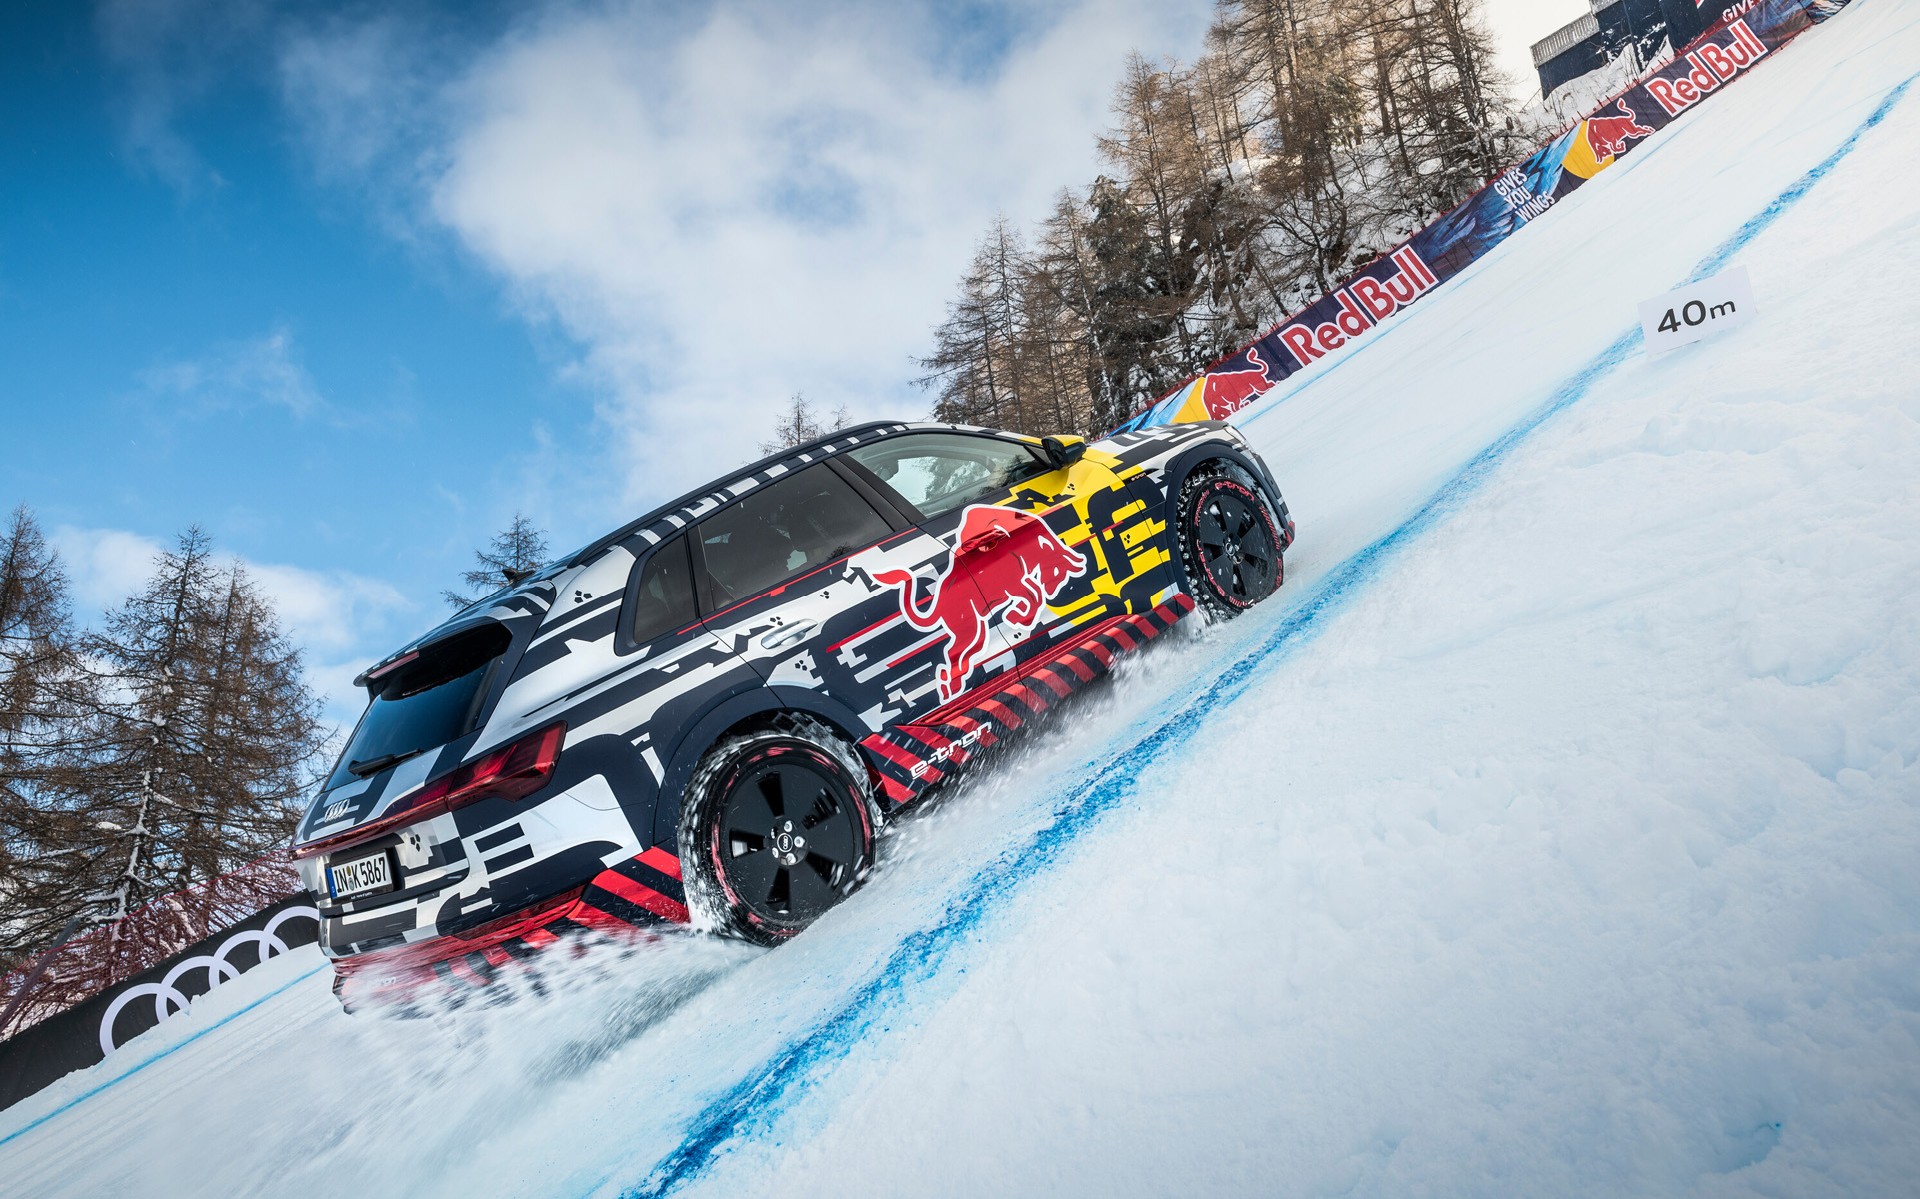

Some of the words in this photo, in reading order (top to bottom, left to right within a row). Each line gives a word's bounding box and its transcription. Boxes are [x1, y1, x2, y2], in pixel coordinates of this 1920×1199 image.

[1494, 168, 1528, 196] GIVES
[1504, 186, 1532, 209] YOU
[1515, 191, 1555, 222] WINGS
[1657, 300, 1736, 333] 40m
[1215, 481, 1255, 501] e-tron
[909, 721, 992, 780] e-tron
[334, 868, 349, 893] IN
[351, 865, 362, 888] K
[360, 857, 387, 887] 5867
